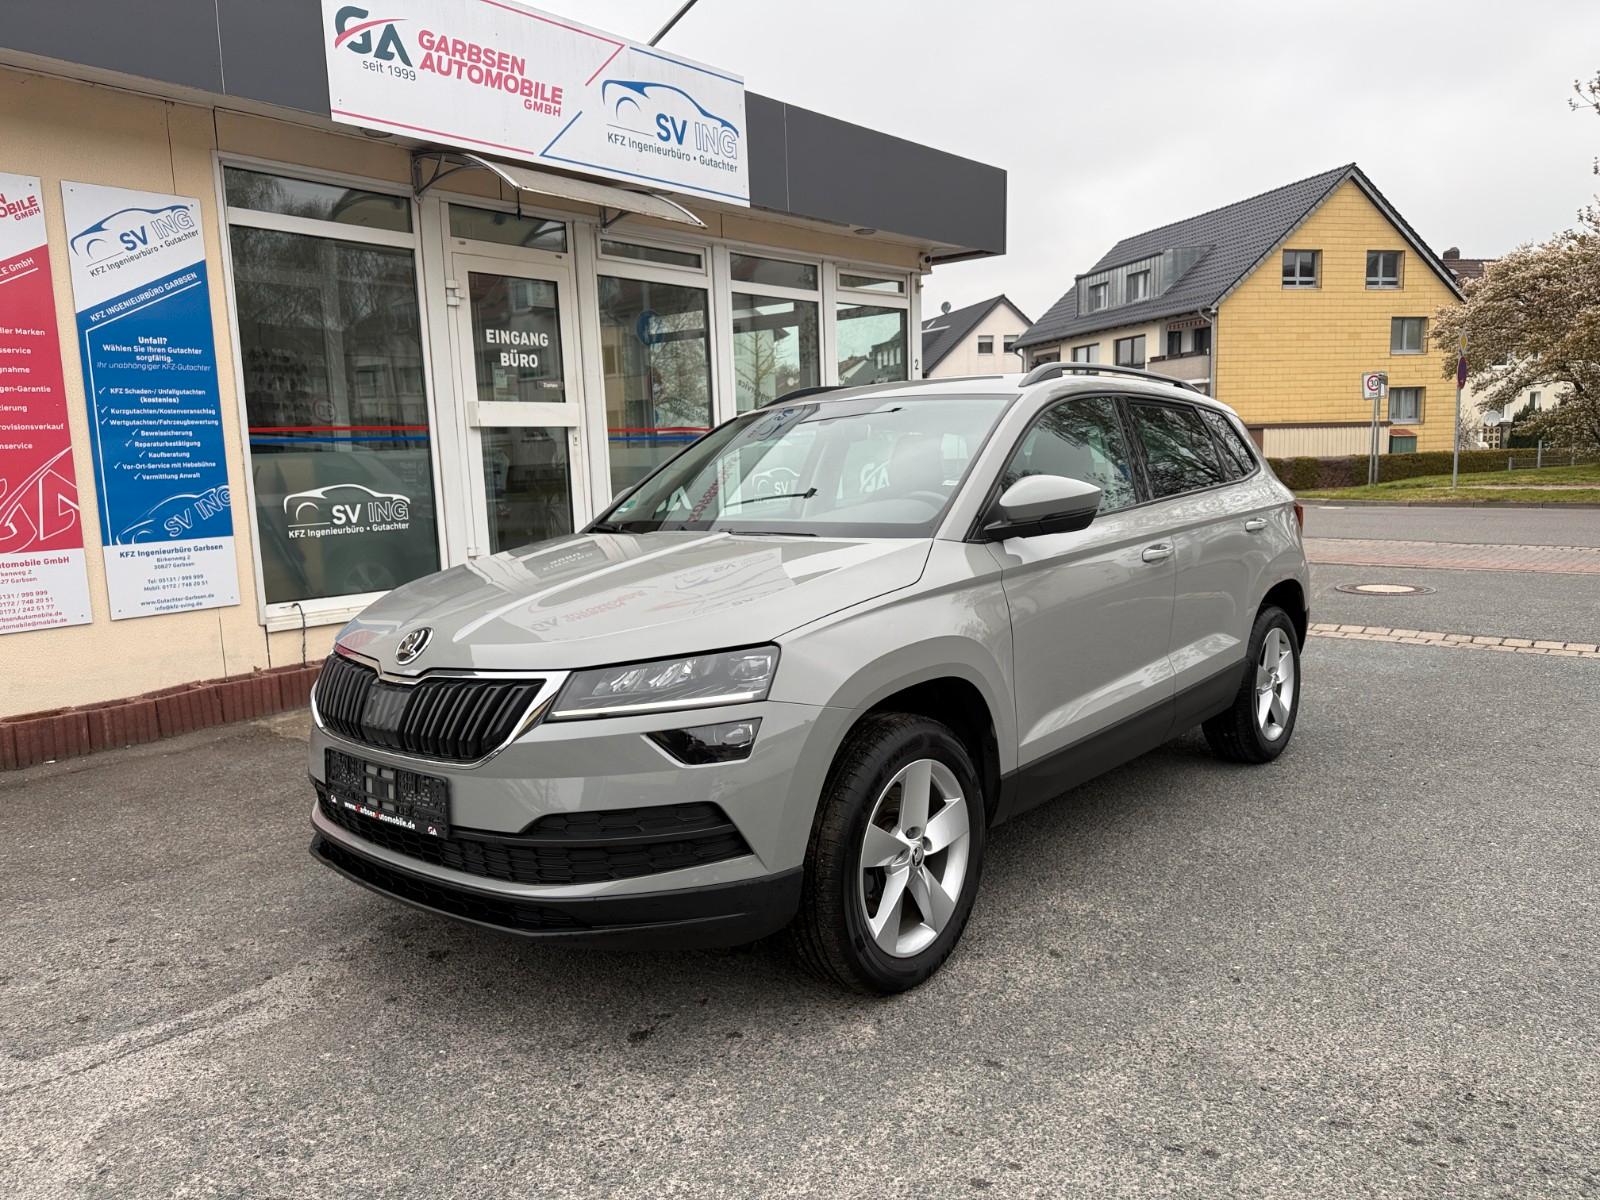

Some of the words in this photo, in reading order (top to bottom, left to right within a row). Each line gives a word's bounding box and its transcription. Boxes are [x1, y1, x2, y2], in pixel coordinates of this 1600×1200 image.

[418, 29, 526, 76] GARBSEN
[362, 60, 384, 73] seit
[387, 65, 417, 81] 1999
[419, 52, 564, 105] AUTOMOBILE
[523, 98, 562, 117] GMBH
[655, 113, 688, 146] SV
[694, 121, 738, 160] ING
[607, 132, 626, 146] KFZ
[628, 137, 692, 162] Ingenieurbüro
[699, 155, 739, 173] Gutachter
[14, 206, 41, 221] GMBH
[119, 225, 149, 251] SV
[150, 210, 195, 241] ING
[89, 265, 108, 278] KFZ
[107, 245, 160, 271] Ingenieurbüro
[163, 229, 200, 248] Gutachter
[9, 257, 35, 272] GmbH
[90, 308, 108, 323] KFZ
[106, 286, 165, 316] INGENIEURBÜRO
[164, 271, 198, 291] GARBSEN
[15, 328, 45, 336] Marken
[485, 329, 549, 347] EINGANG
[138, 336, 168, 345] Unfall?
[102, 344, 132, 353] Wählen
[134, 345, 145, 353] Sie
[147, 346, 166, 354] Ihren
[167, 347, 202, 355] Gutachter
[135, 354, 174, 363] sorgfältig.
[500, 349, 539, 368] BÜRO
[914, 358, 920, 370] 2
[108, 362, 160, 371] unabhängiger
[161, 363, 211, 372] KFZ-Gutachter
[110, 387, 124, 395] KFZ
[139, 396, 180, 404] (kostenlos)
[110, 408, 216, 416] Kurzgutachten/Kostenvoranschlag
[134, 440, 201, 448] Reparaturbestätigung
[148, 451, 190, 459] Kaufberatung
[141, 473, 179, 481] Vermittlung
[331, 503, 361, 525] SV
[368, 500, 409, 522] ING
[163, 508, 193, 537] SV
[288, 530, 306, 539] KFZ
[307, 526, 364, 538] Ingenieurbüro
[372, 522, 410, 531] Gutachter
[119, 551, 136, 559] KFZ
[137, 547, 192, 558] Ingenieurbüro
[193, 544, 224, 552] Garbsen
[43, 556, 70, 565] GmbH
